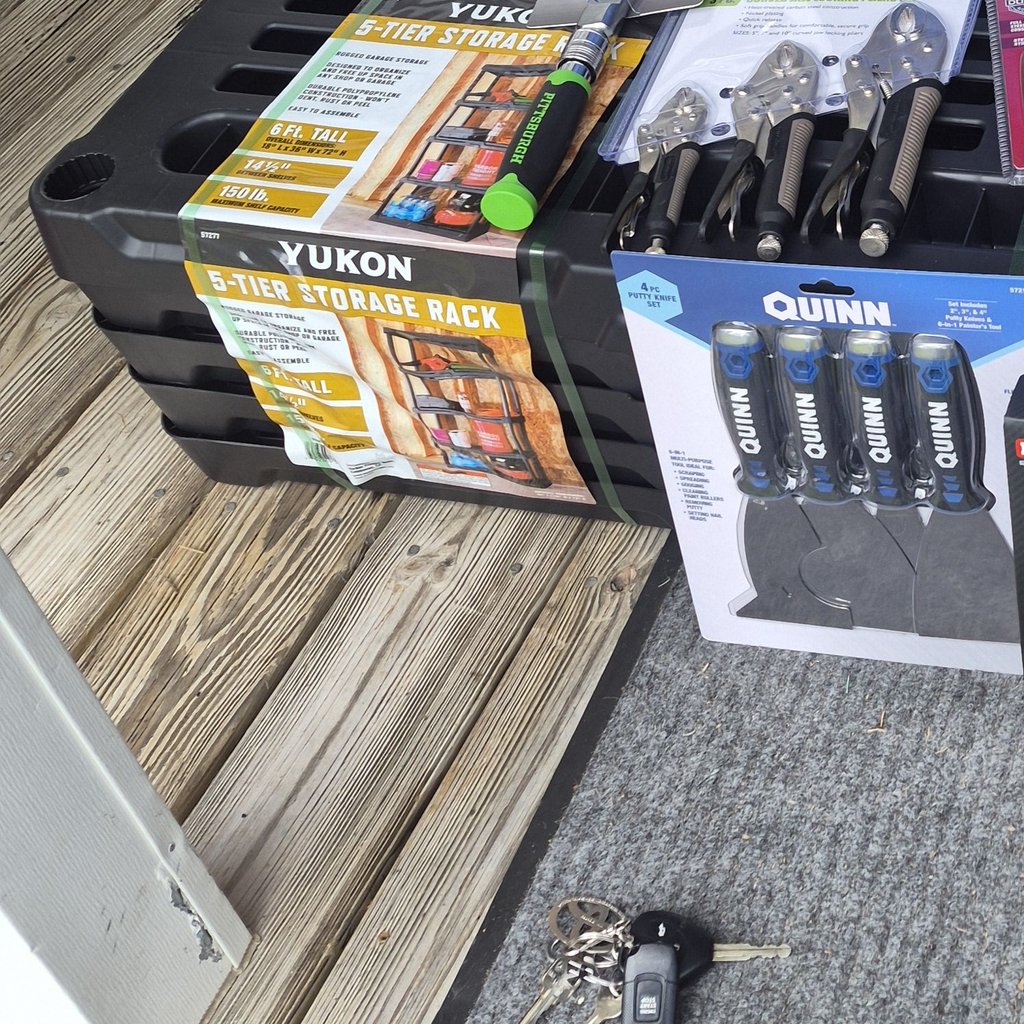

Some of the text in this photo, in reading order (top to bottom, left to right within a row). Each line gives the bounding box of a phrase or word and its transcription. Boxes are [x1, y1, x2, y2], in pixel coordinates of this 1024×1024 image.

[355, 19, 552, 52] 5-TIER STORAGE
[366, 54, 394, 62] GARAGE
[395, 57, 430, 65] STORAGE
[326, 62, 362, 70] DESIGNED
[375, 66, 411, 75] ORGANIZE
[366, 78, 396, 86] GARAGE
[303, 90, 359, 100] CONSTRUCTION
[307, 84, 402, 98] DURABLE POLYPROPYLENE
[320, 109, 360, 118] ASSEMBLE
[269, 124, 348, 143] 6 Ft. TALL
[510, 92, 556, 164] PITTSBURGH
[219, 186, 268, 202] 150 lb.
[210, 198, 300, 214] MAXIMUM SHELF CAPACITY
[277, 240, 413, 282] YUKON
[641, 282, 648, 291] 4
[206, 269, 501, 330] 5-TIER STORAGE RACK
[628, 292, 677, 302] PUTTY KNIFE
[763, 291, 891, 326] QUINN
[729, 387, 762, 454] QUINN
[795, 392, 827, 459] QUINN
[862, 396, 892, 463] QUINN
[927, 401, 959, 468] QUINN
